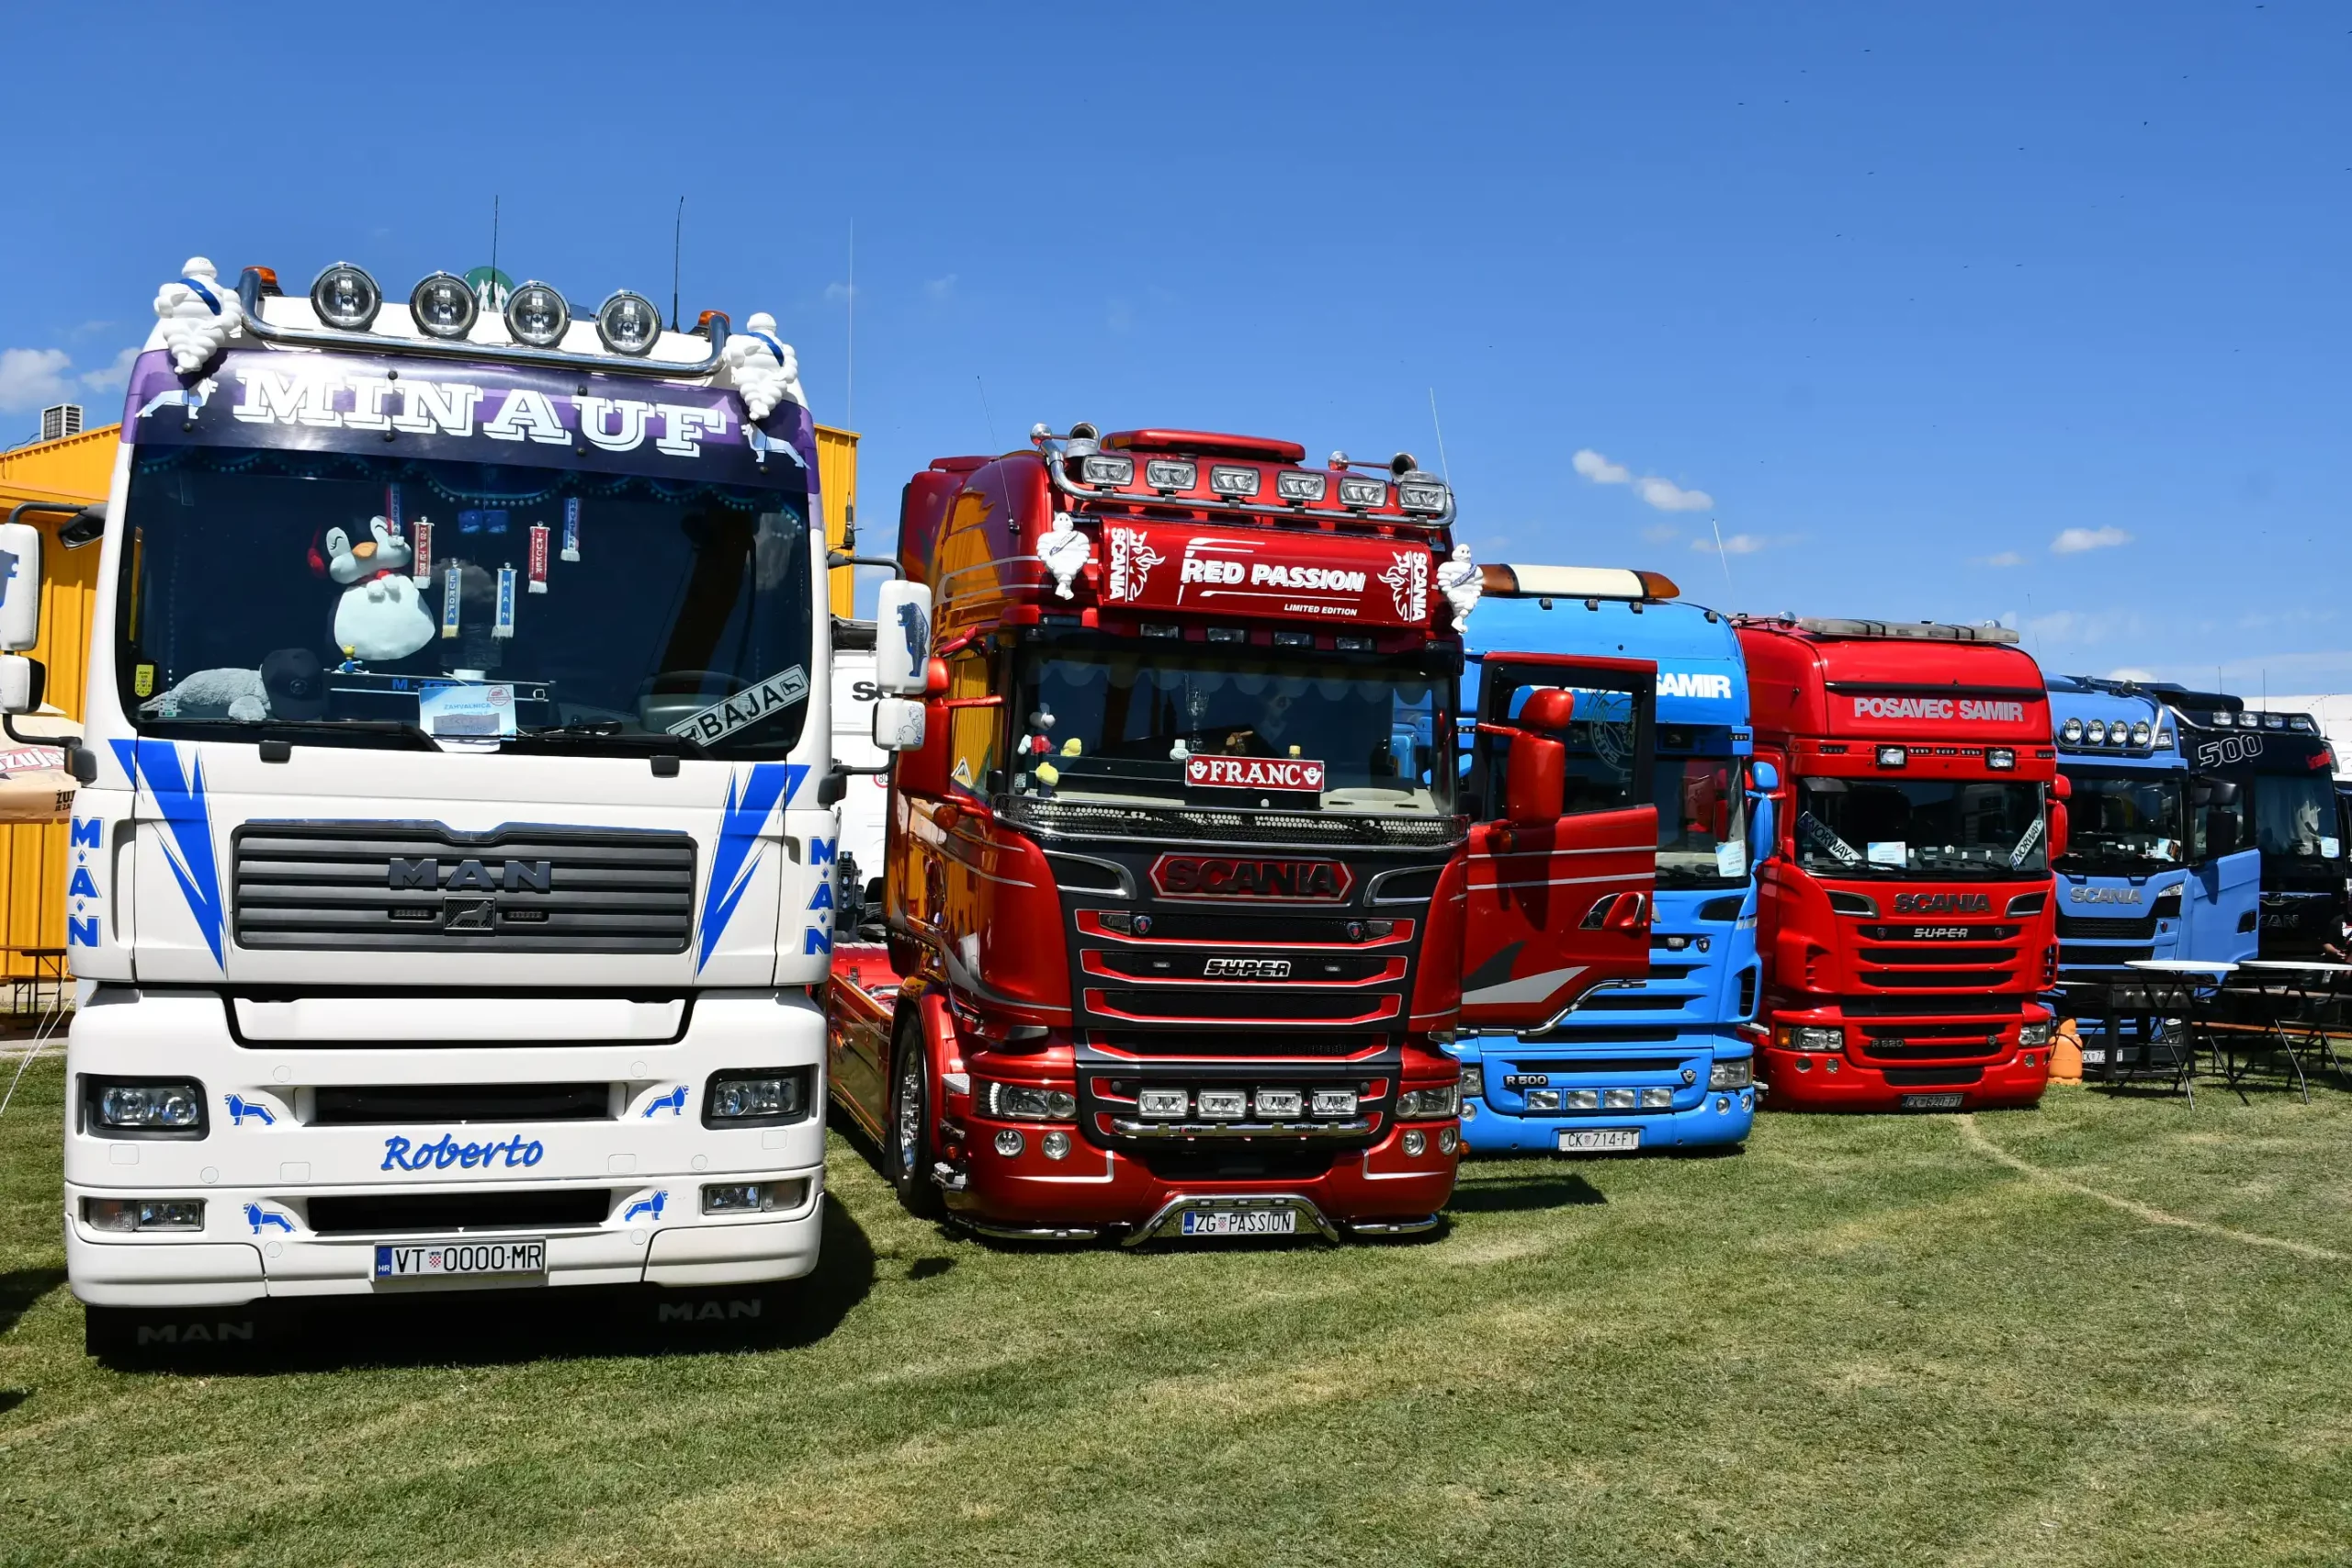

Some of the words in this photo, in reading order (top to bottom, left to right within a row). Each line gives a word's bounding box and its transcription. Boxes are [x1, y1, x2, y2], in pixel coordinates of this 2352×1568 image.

[233, 369, 727, 457] MINAUF
[1109, 526, 1126, 600] SCANIA
[1181, 558, 1245, 584] RED
[1250, 563, 1366, 592] PASSION
[1412, 552, 1428, 621] SCANIA
[1283, 604, 1320, 614] LIMITED
[1321, 606, 1358, 616] EDITION
[697, 684, 785, 739] BAJA
[1854, 698, 1953, 719] POSAVEC
[1959, 700, 2023, 722] SAMIR
[2199, 735, 2263, 768] 500
[1209, 760, 1301, 785] FRANC
[1809, 819, 1852, 859] NORWAY
[2014, 822, 2040, 858] NORWAY
[388, 856, 551, 894] MAN
[1163, 858, 1340, 897] SCANIA
[1894, 893, 1991, 914] SCANIA
[2069, 887, 2143, 905] SCANIA
[1914, 928, 1968, 938] SUPER
[1204, 958, 1291, 977] SUPER
[1506, 1076, 1516, 1085] R
[1518, 1076, 1547, 1085] 500
[380, 1133, 544, 1171] Roberto
[1567, 1133, 1582, 1147] CK
[1195, 1214, 1216, 1232] ZG
[1228, 1213, 1291, 1232] PASSION
[378, 1264, 390, 1272] HR
[395, 1248, 425, 1273] VT
[659, 1299, 762, 1322] MAN
[138, 1321, 254, 1346] MAN
